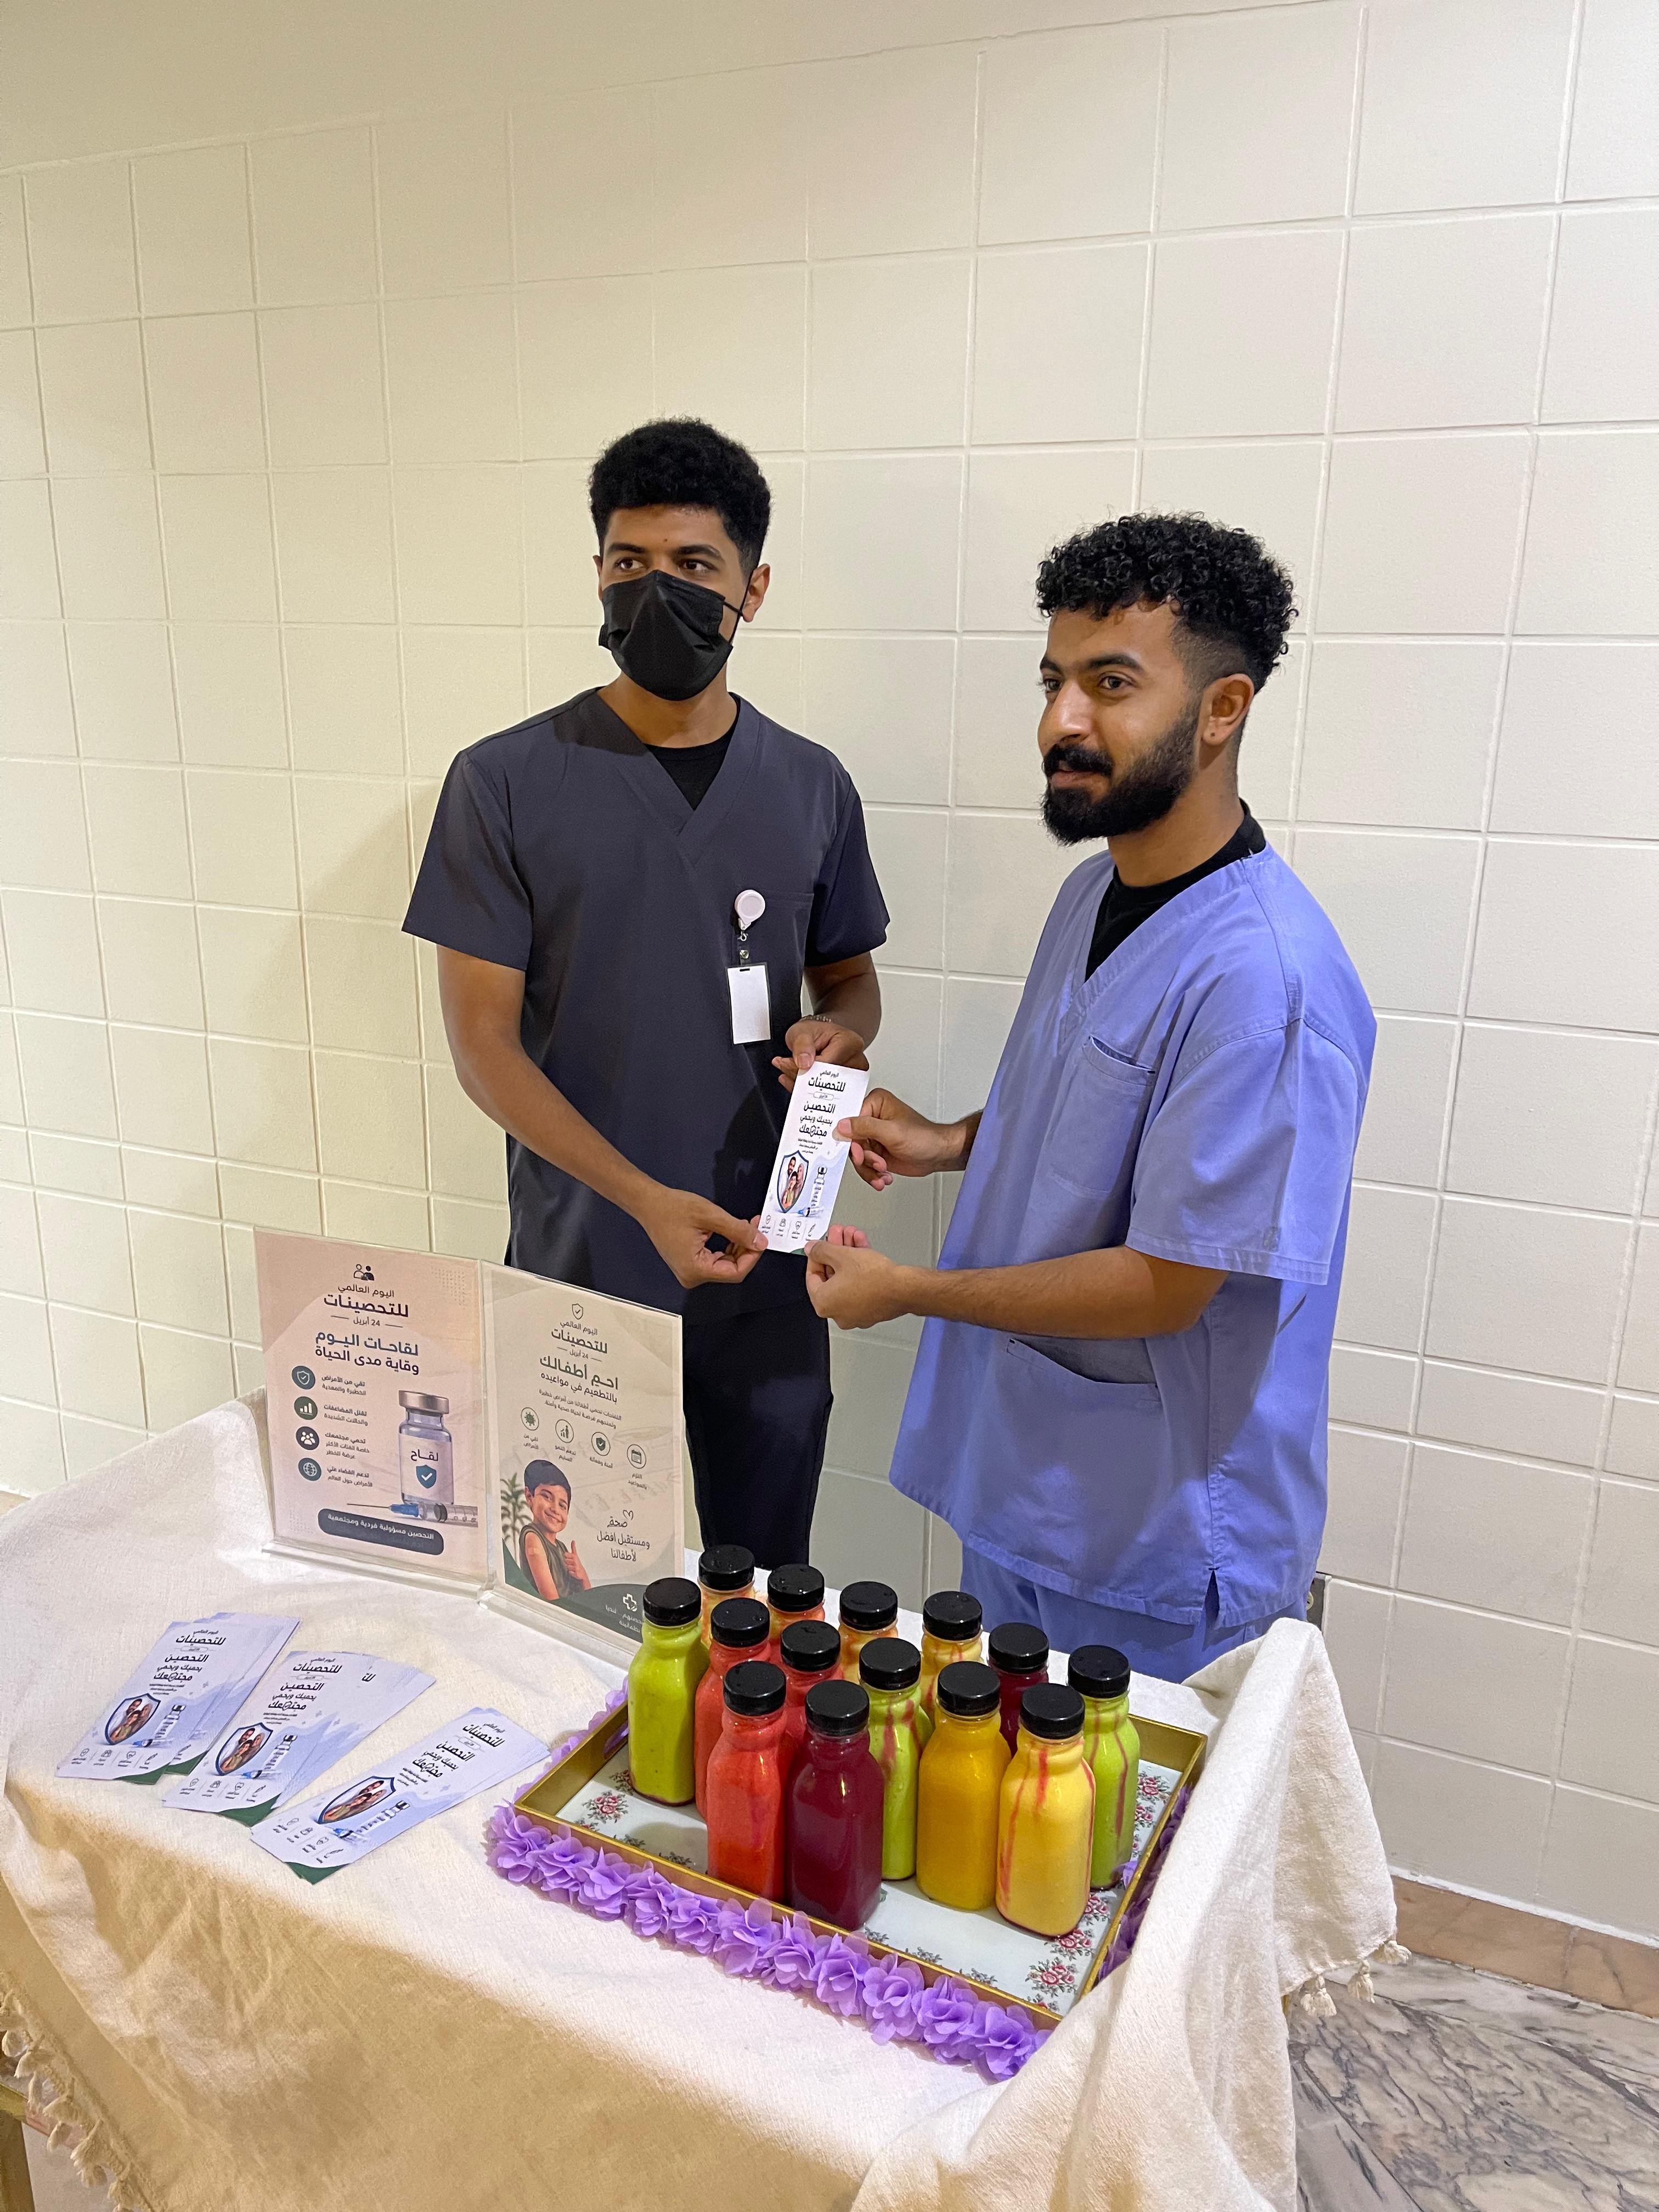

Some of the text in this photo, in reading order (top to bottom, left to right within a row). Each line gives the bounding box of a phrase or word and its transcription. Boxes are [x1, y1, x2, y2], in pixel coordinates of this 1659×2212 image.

[808, 1076, 845, 1092] للتحصينات
[804, 1101, 836, 1114] التحصين
[816, 1116, 833, 1126] يحميك
[338, 1284, 394, 1299] اليوم العالمي
[324, 1294, 409, 1318] للتحصينات
[560, 1321, 598, 1335] اليوم العالمي
[316, 1332, 418, 1356] لقاحات اليوم
[551, 1329, 607, 1354] للتحصينات
[315, 1345, 419, 1375] وقاية مدى الحياة
[540, 1356, 588, 1380] أطفالك
[321, 1383, 345, 1393] والمعدية
[541, 1373, 618, 1404] بالتطعيم في مواعيده
[323, 1404, 353, 1414] المضاعفات
[324, 1413, 368, 1426] والحالات الشديدة
[325, 1432, 349, 1441] مجتمعك
[410, 1449, 438, 1462] لقاح
[328, 1513, 434, 1540] التحصين مسؤولية فردية ومجتمعية
[618, 1533, 650, 1550] ومستقبل
[611, 1548, 636, 1561] لأطفالنا
[176, 1635, 227, 1646] للتحصينات
[165, 1654, 210, 1663] التحصين
[293, 1663, 343, 1674] للتحصينات
[280, 1682, 324, 1692] التحصين
[295, 1692, 317, 1701] يحميك
[462, 1724, 505, 1747] للتحصينات
[436, 1741, 476, 1762] التحصين
